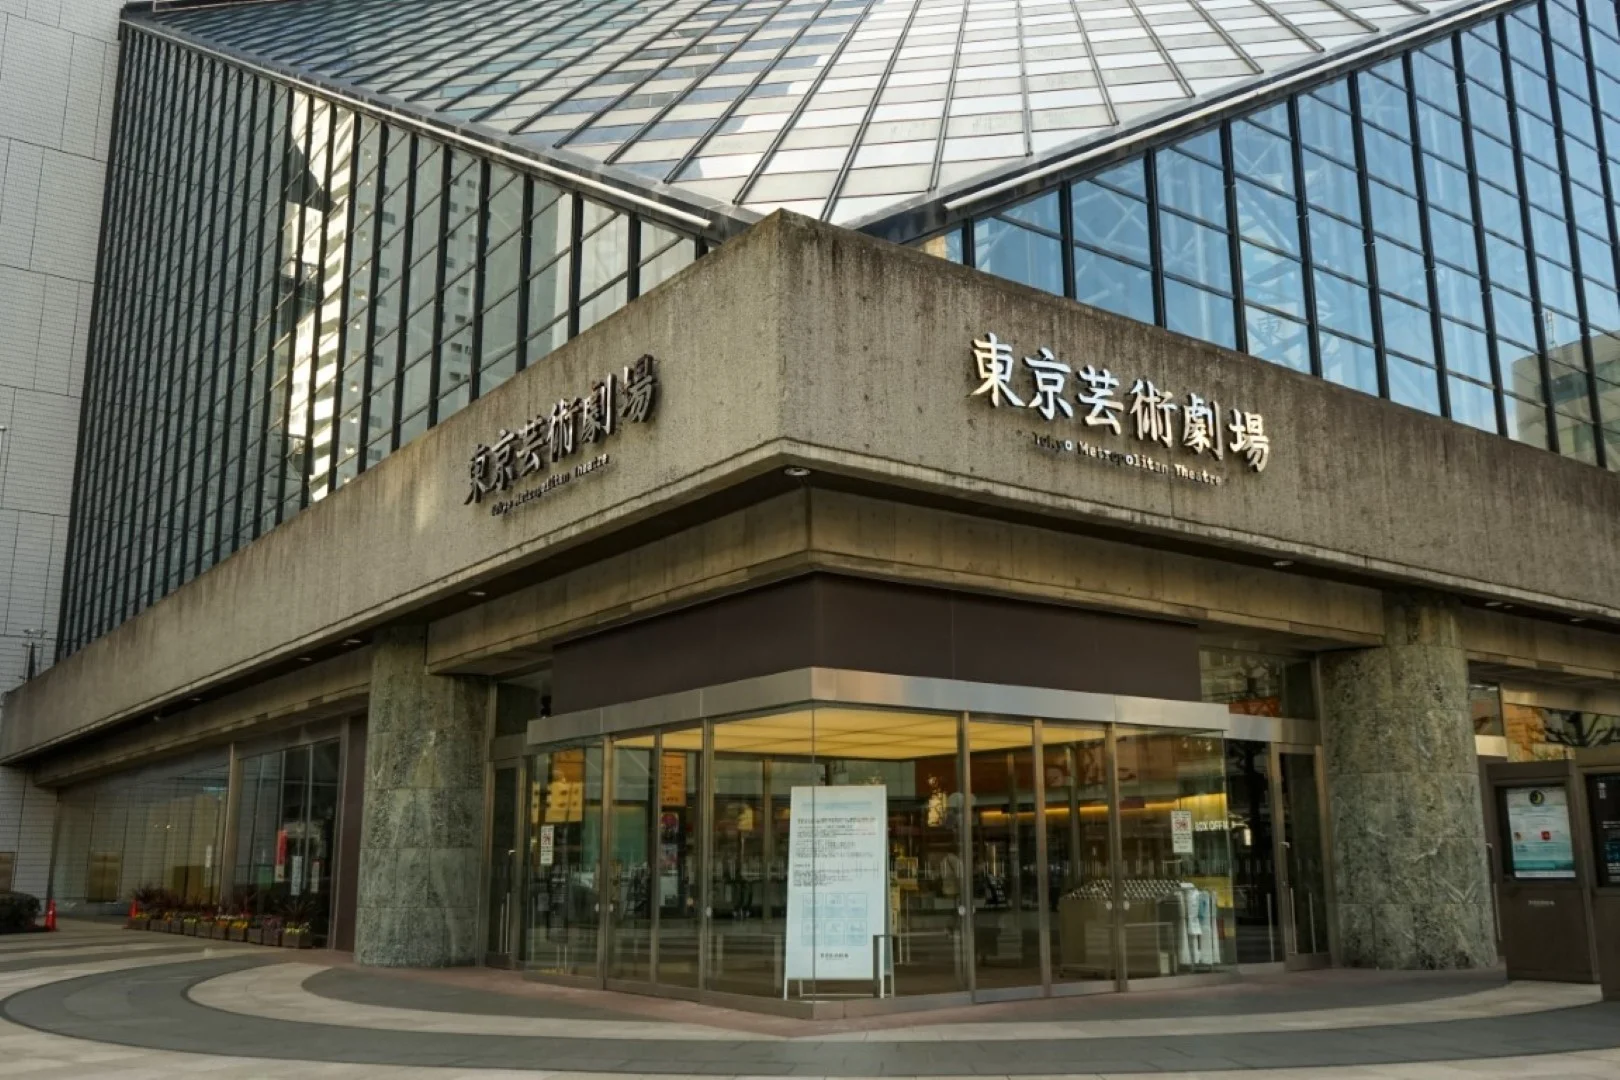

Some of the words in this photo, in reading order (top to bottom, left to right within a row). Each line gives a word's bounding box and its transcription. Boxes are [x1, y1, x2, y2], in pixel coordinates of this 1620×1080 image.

[463, 353, 657, 505] 東京芸術劇場
[970, 331, 1270, 474] 東京芸術劇場
[1173, 463, 1222, 485] Theatre
